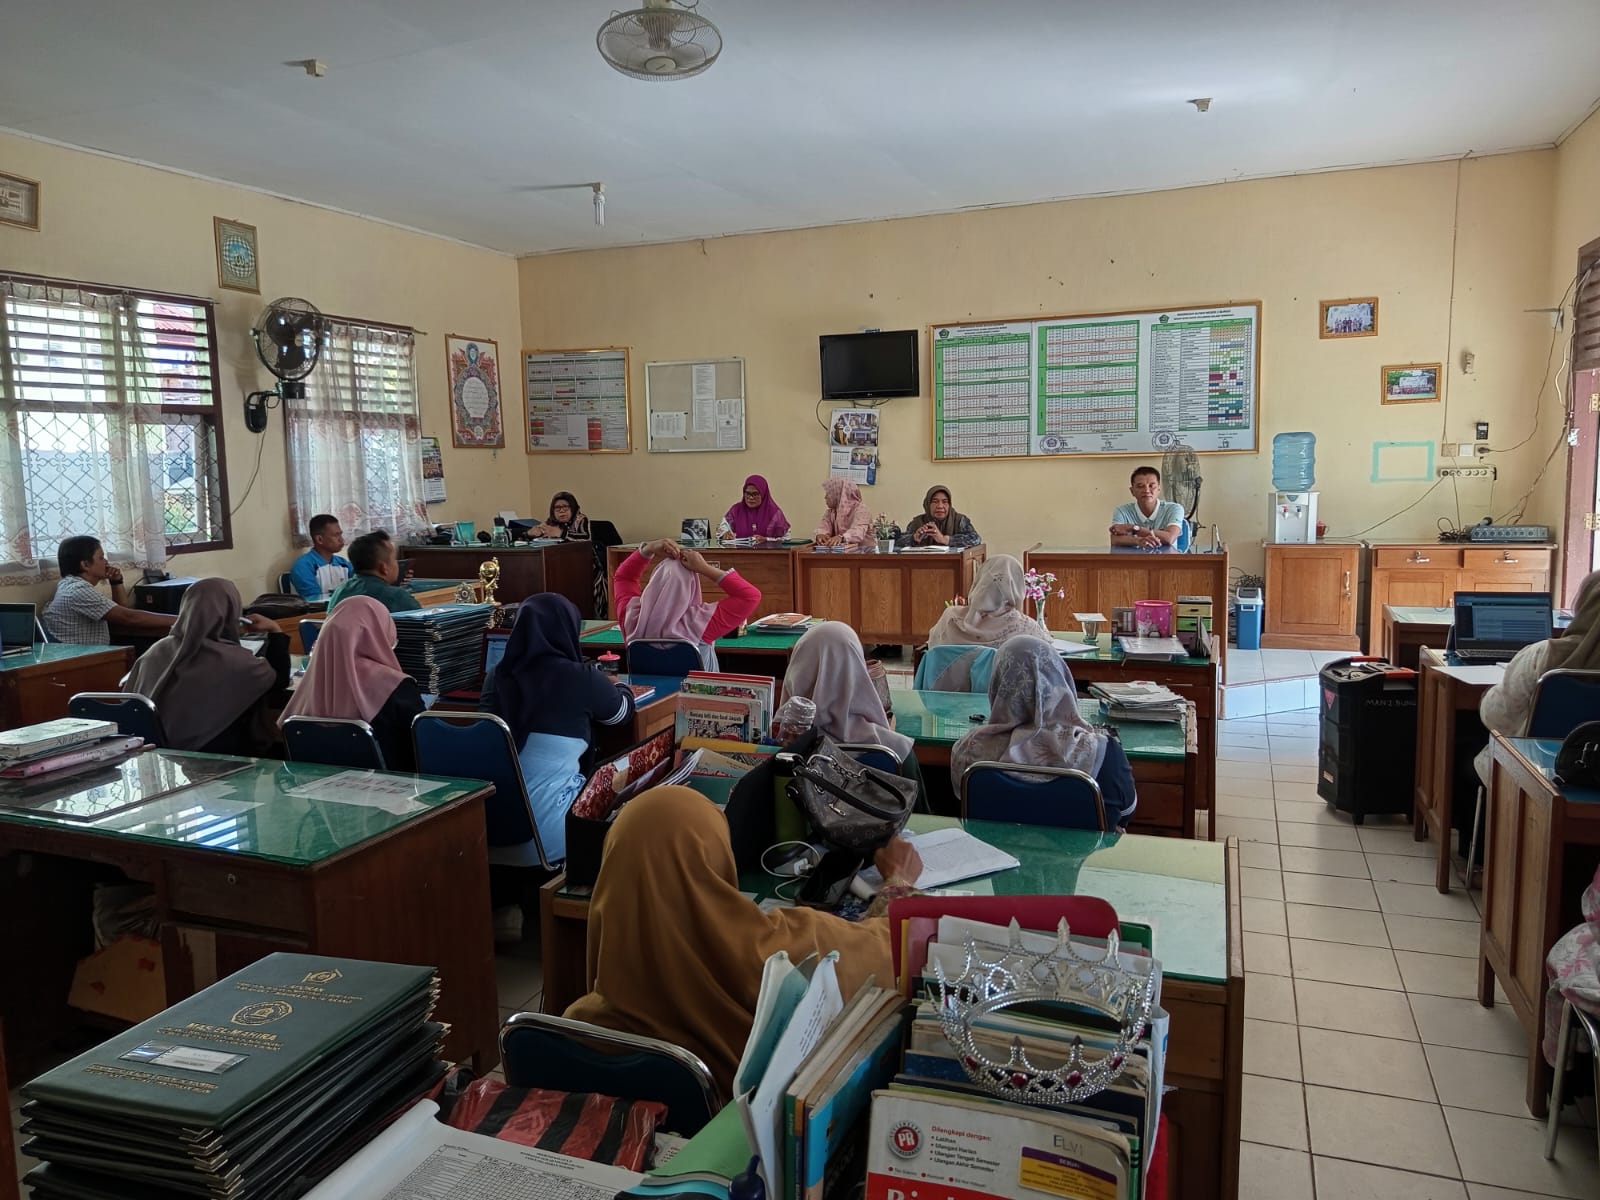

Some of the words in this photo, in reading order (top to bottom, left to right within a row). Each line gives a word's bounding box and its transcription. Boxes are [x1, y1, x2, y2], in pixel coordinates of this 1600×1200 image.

[898, 1131, 916, 1147] PR
[931, 1125, 965, 1138] Dilengkapi
[966, 1131, 993, 1142] dengan:
[935, 1136, 956, 1144] Latihan
[935, 1143, 958, 1152] Ulangan
[958, 1147, 977, 1155] Harian
[934, 1150, 956, 1159] Ulangan
[957, 1153, 976, 1162] Tengah
[976, 1157, 1000, 1167] Semester
[934, 1157, 955, 1166] Ulangan
[970, 1164, 994, 1173] Semester
